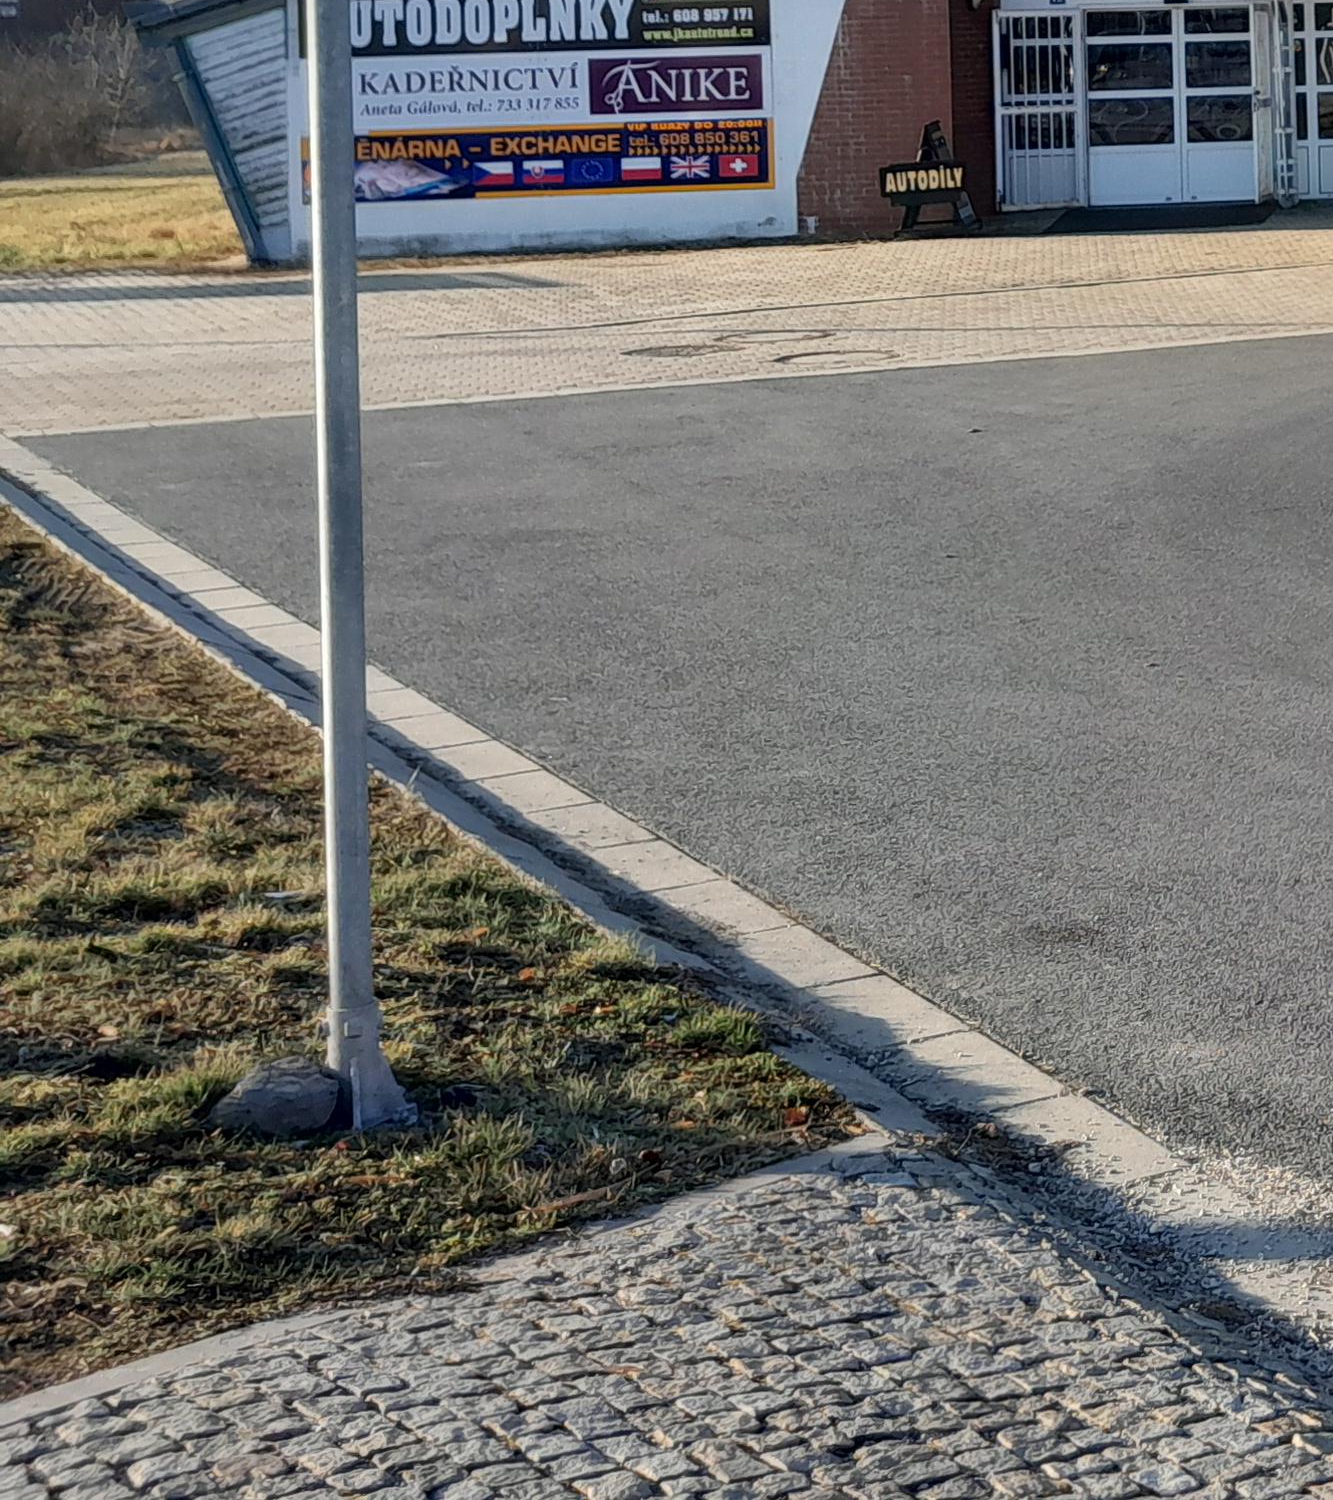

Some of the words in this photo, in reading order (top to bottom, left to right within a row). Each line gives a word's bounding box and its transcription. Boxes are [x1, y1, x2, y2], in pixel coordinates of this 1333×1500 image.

[642, 10, 669, 24] tel.:
[673, 8, 700, 23] 608
[703, 7, 729, 22] 957
[733, 7, 753, 21] 171
[359, 62, 579, 96] KADEŘNICTVÍ
[603, 60, 750, 107] ANIKE
[360, 102, 403, 117] Aneta
[407, 100, 462, 116] Gálová,
[466, 98, 493, 114] tel.:
[497, 98, 522, 112] 733
[526, 98, 551, 111] 317
[554, 97, 580, 110] 855
[356, 136, 462, 161] ĚNÁRNA
[490, 132, 621, 157] EXCHANGE
[659, 132, 691, 146] 608
[694, 131, 726, 145] 850
[729, 130, 760, 144] 361
[885, 164, 963, 193] AUTODÍLY
